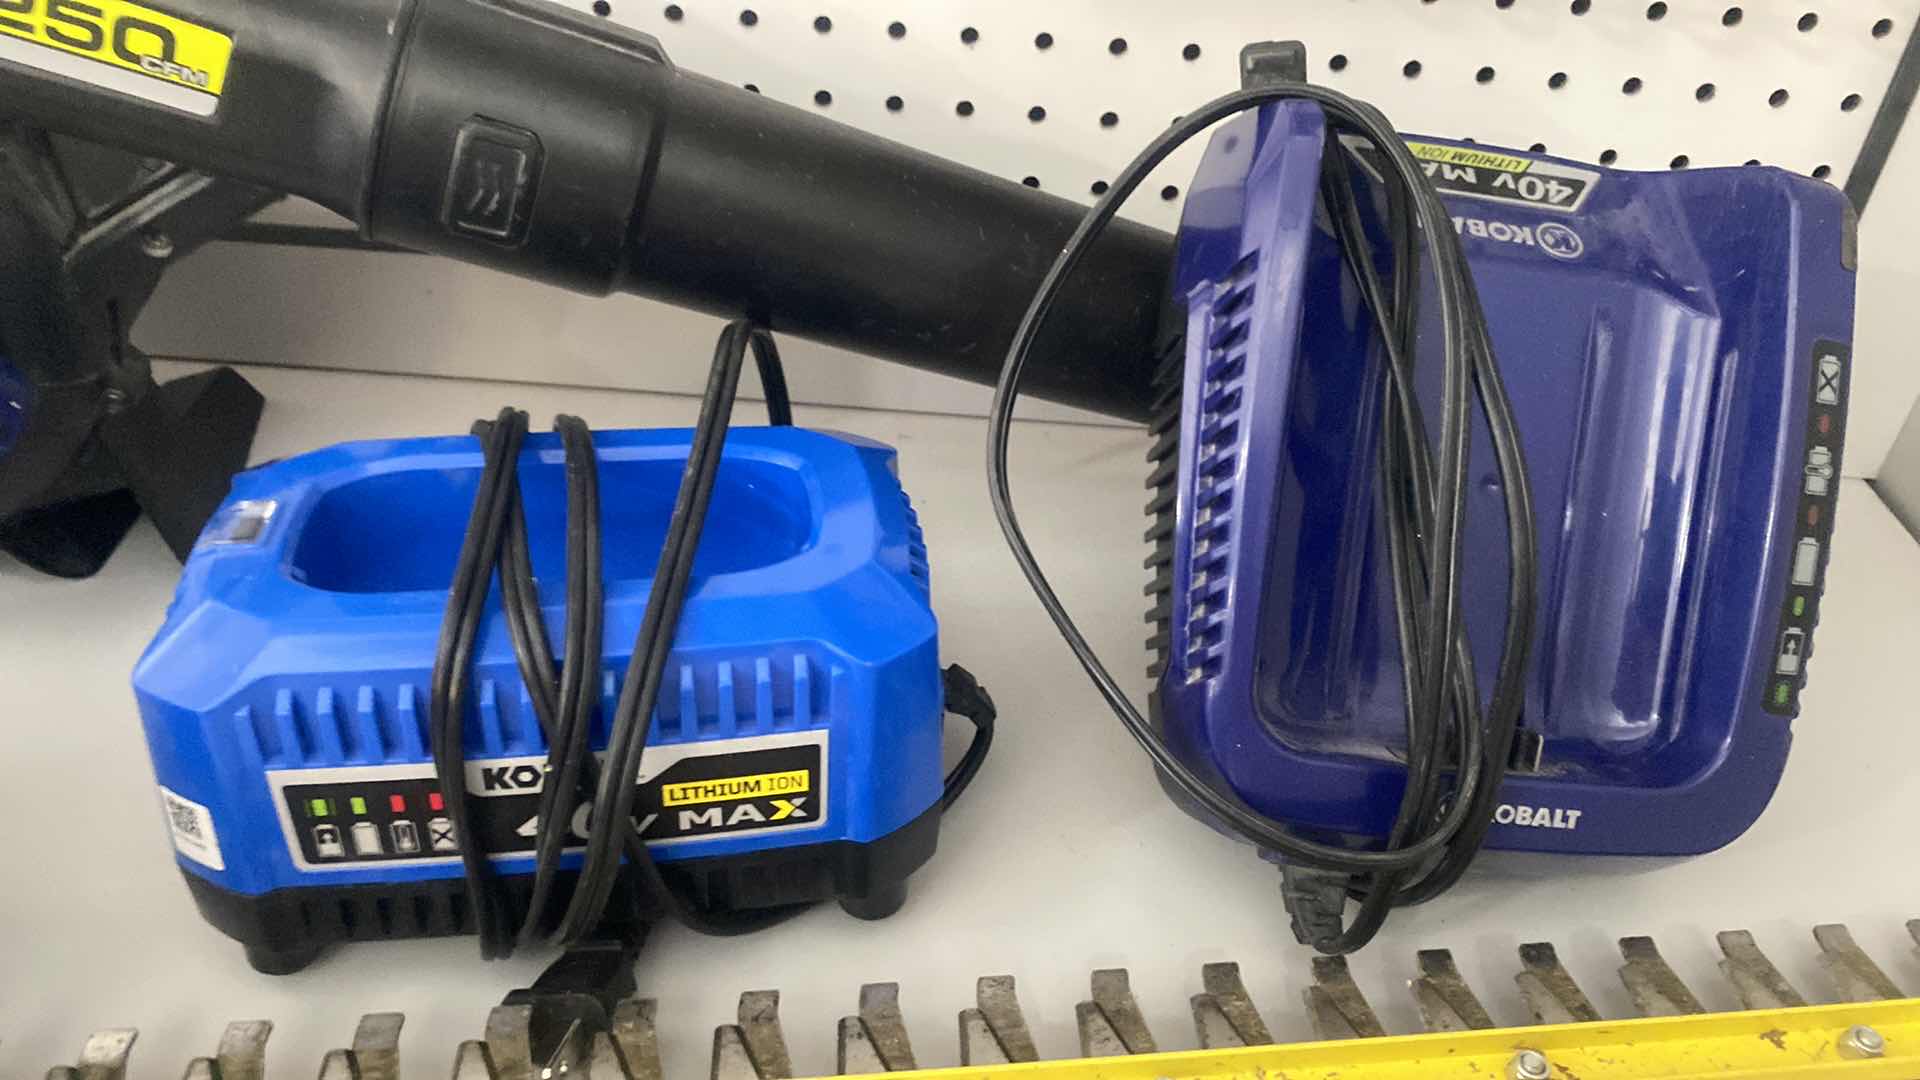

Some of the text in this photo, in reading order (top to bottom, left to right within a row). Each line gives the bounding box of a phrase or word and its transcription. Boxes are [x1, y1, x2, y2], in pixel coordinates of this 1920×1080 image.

[139, 54, 209, 87] CFM
[1418, 145, 1522, 170] LITHIUM ION
[1422, 163, 1478, 184] MA
[1451, 217, 1535, 246] KOBA
[669, 774, 804, 802] LITHIUM ION
[678, 797, 808, 831] MAX
[1491, 804, 1583, 830] OBALT
